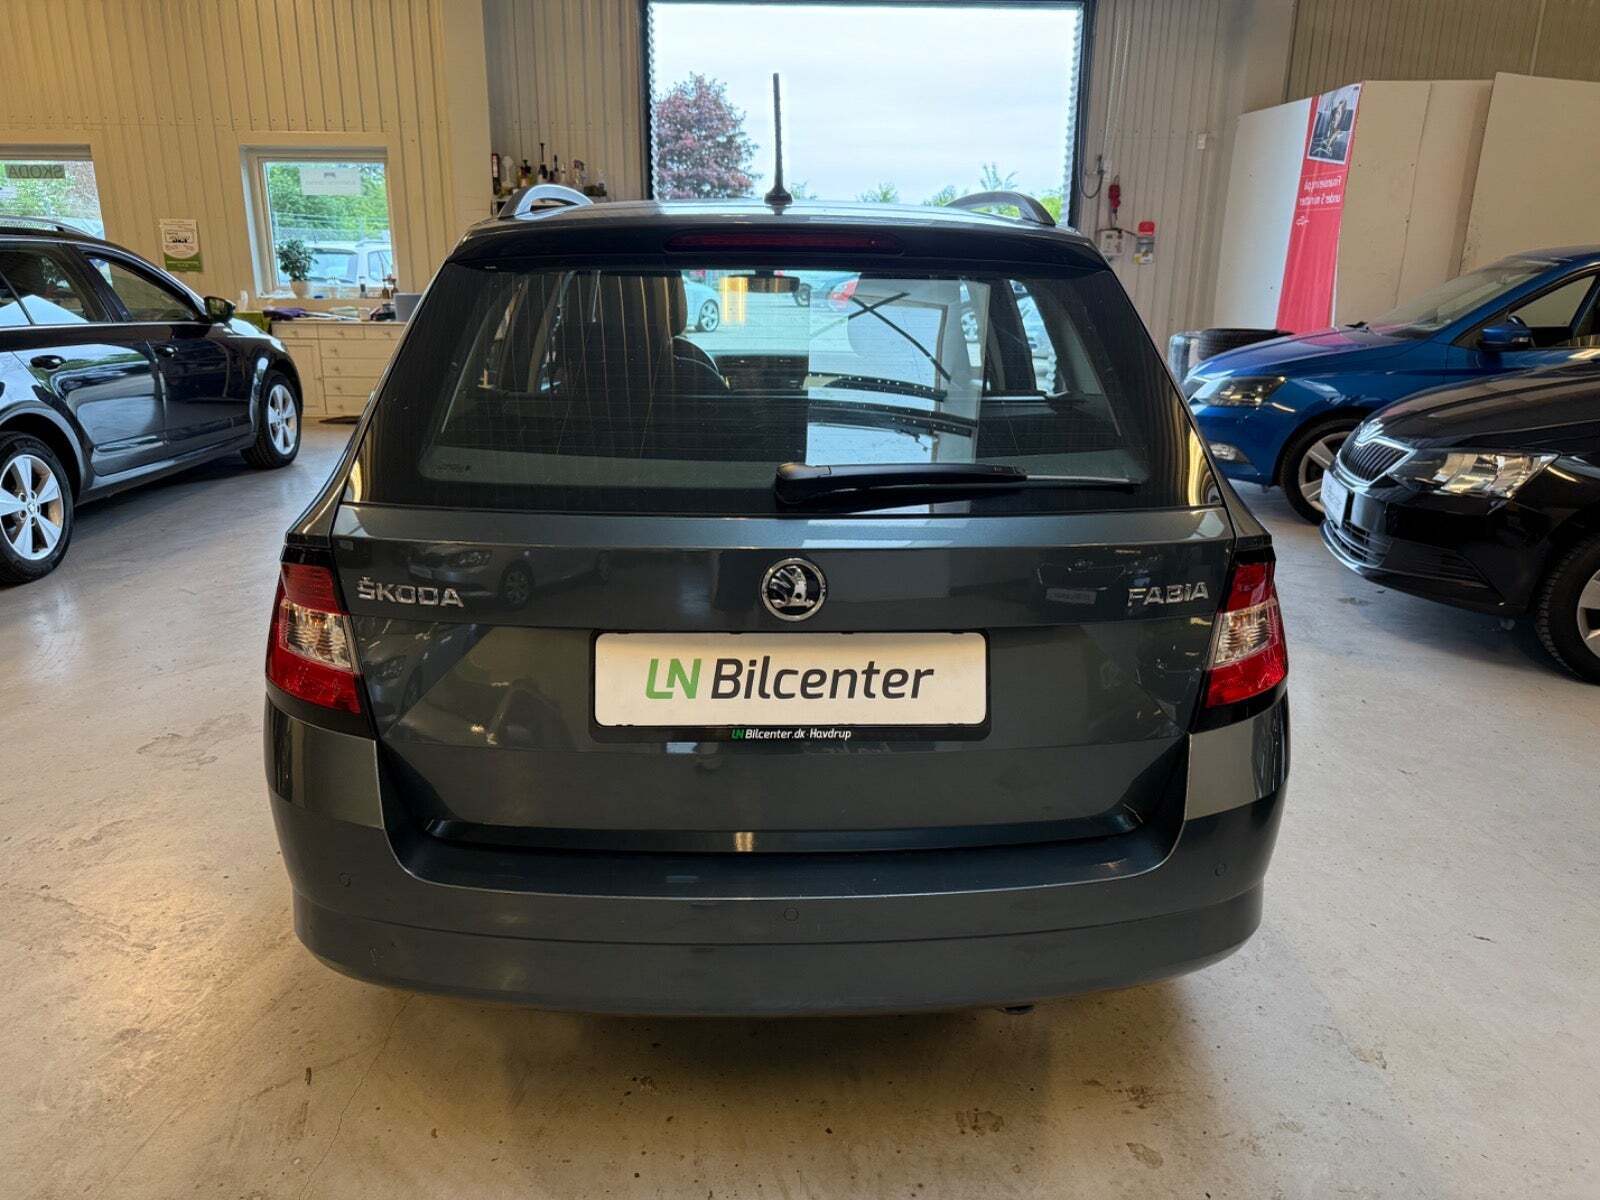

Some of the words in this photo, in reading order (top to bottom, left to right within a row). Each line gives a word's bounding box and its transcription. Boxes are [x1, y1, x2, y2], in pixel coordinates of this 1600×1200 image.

[357, 576, 464, 608] ŠKODA
[1127, 581, 1209, 607] FABIA
[645, 658, 702, 700] LN
[711, 655, 934, 700] Bilcenter
[809, 728, 852, 741] Havdrup
